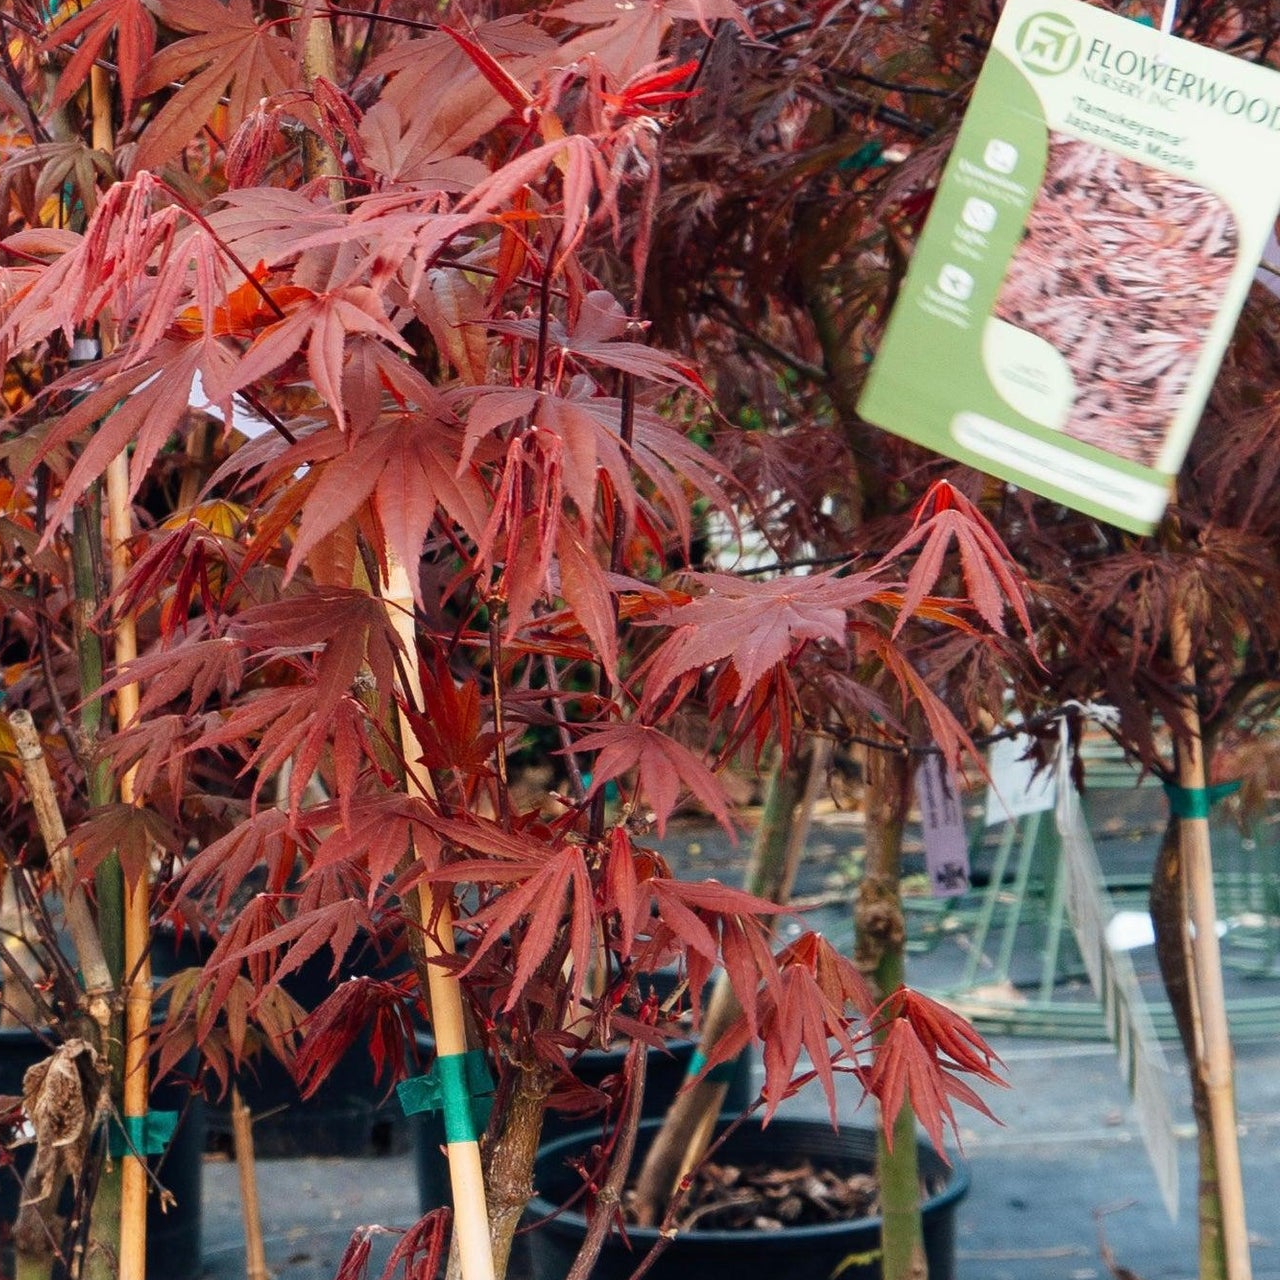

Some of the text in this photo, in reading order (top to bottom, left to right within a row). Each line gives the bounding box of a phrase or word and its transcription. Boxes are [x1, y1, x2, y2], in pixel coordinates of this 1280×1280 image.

[1080, 65, 1146, 98] NURSERY
[1064, 111, 1196, 171] Japanese Maple
